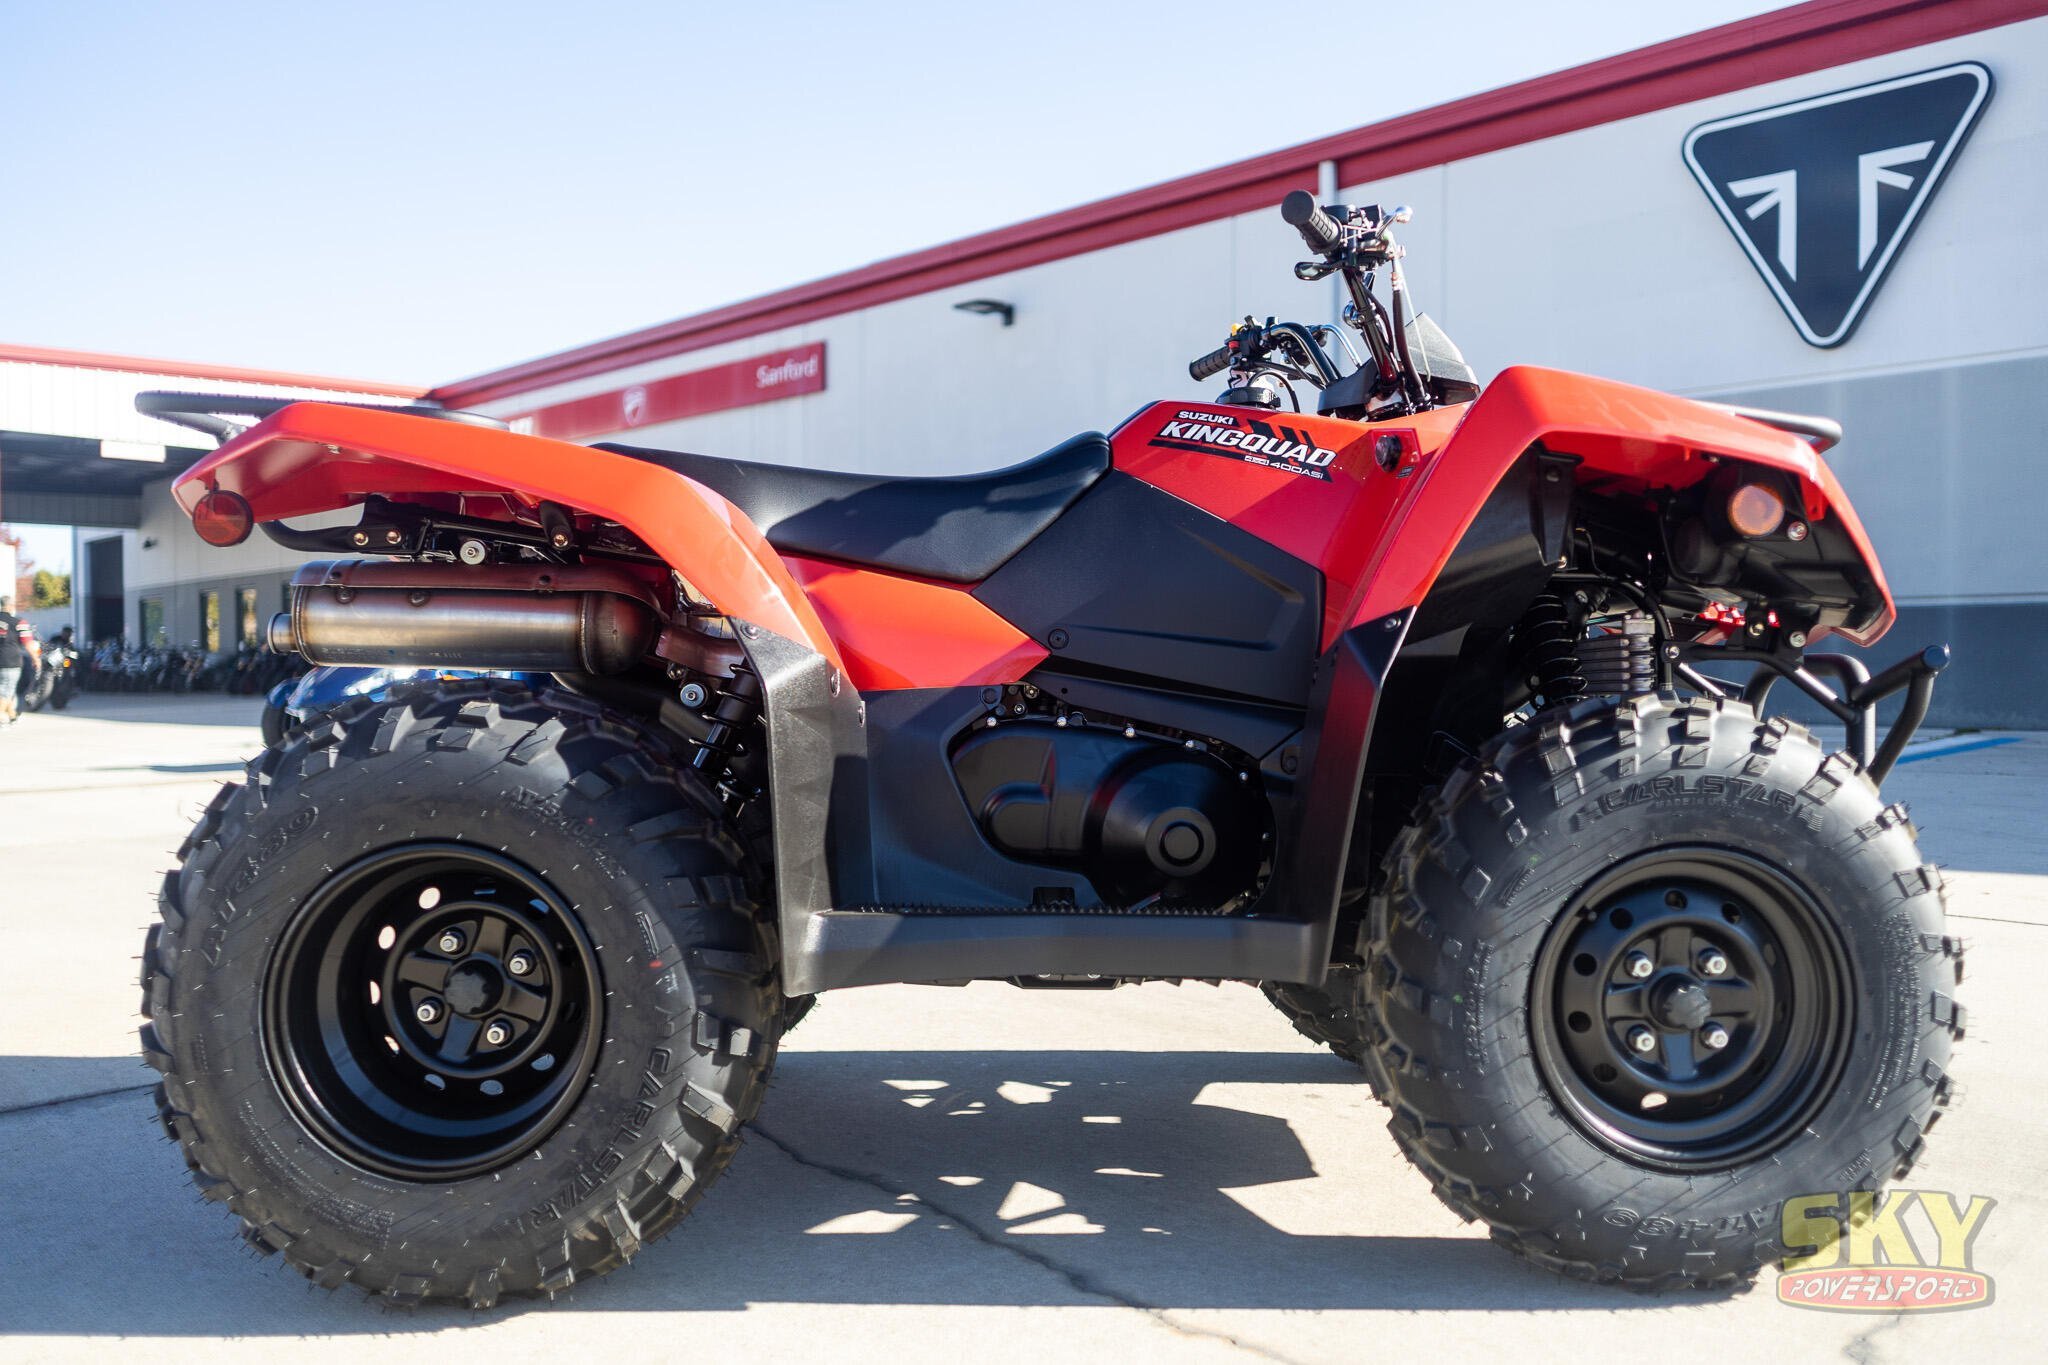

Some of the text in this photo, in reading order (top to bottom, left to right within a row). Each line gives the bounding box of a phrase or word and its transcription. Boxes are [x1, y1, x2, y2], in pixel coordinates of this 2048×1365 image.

[756, 355, 818, 389] Sanford
[1178, 411, 1234, 425] SUZUKI
[1160, 421, 1337, 467] KINGQUAD
[1600, 774, 1797, 815] CARLSTAR
